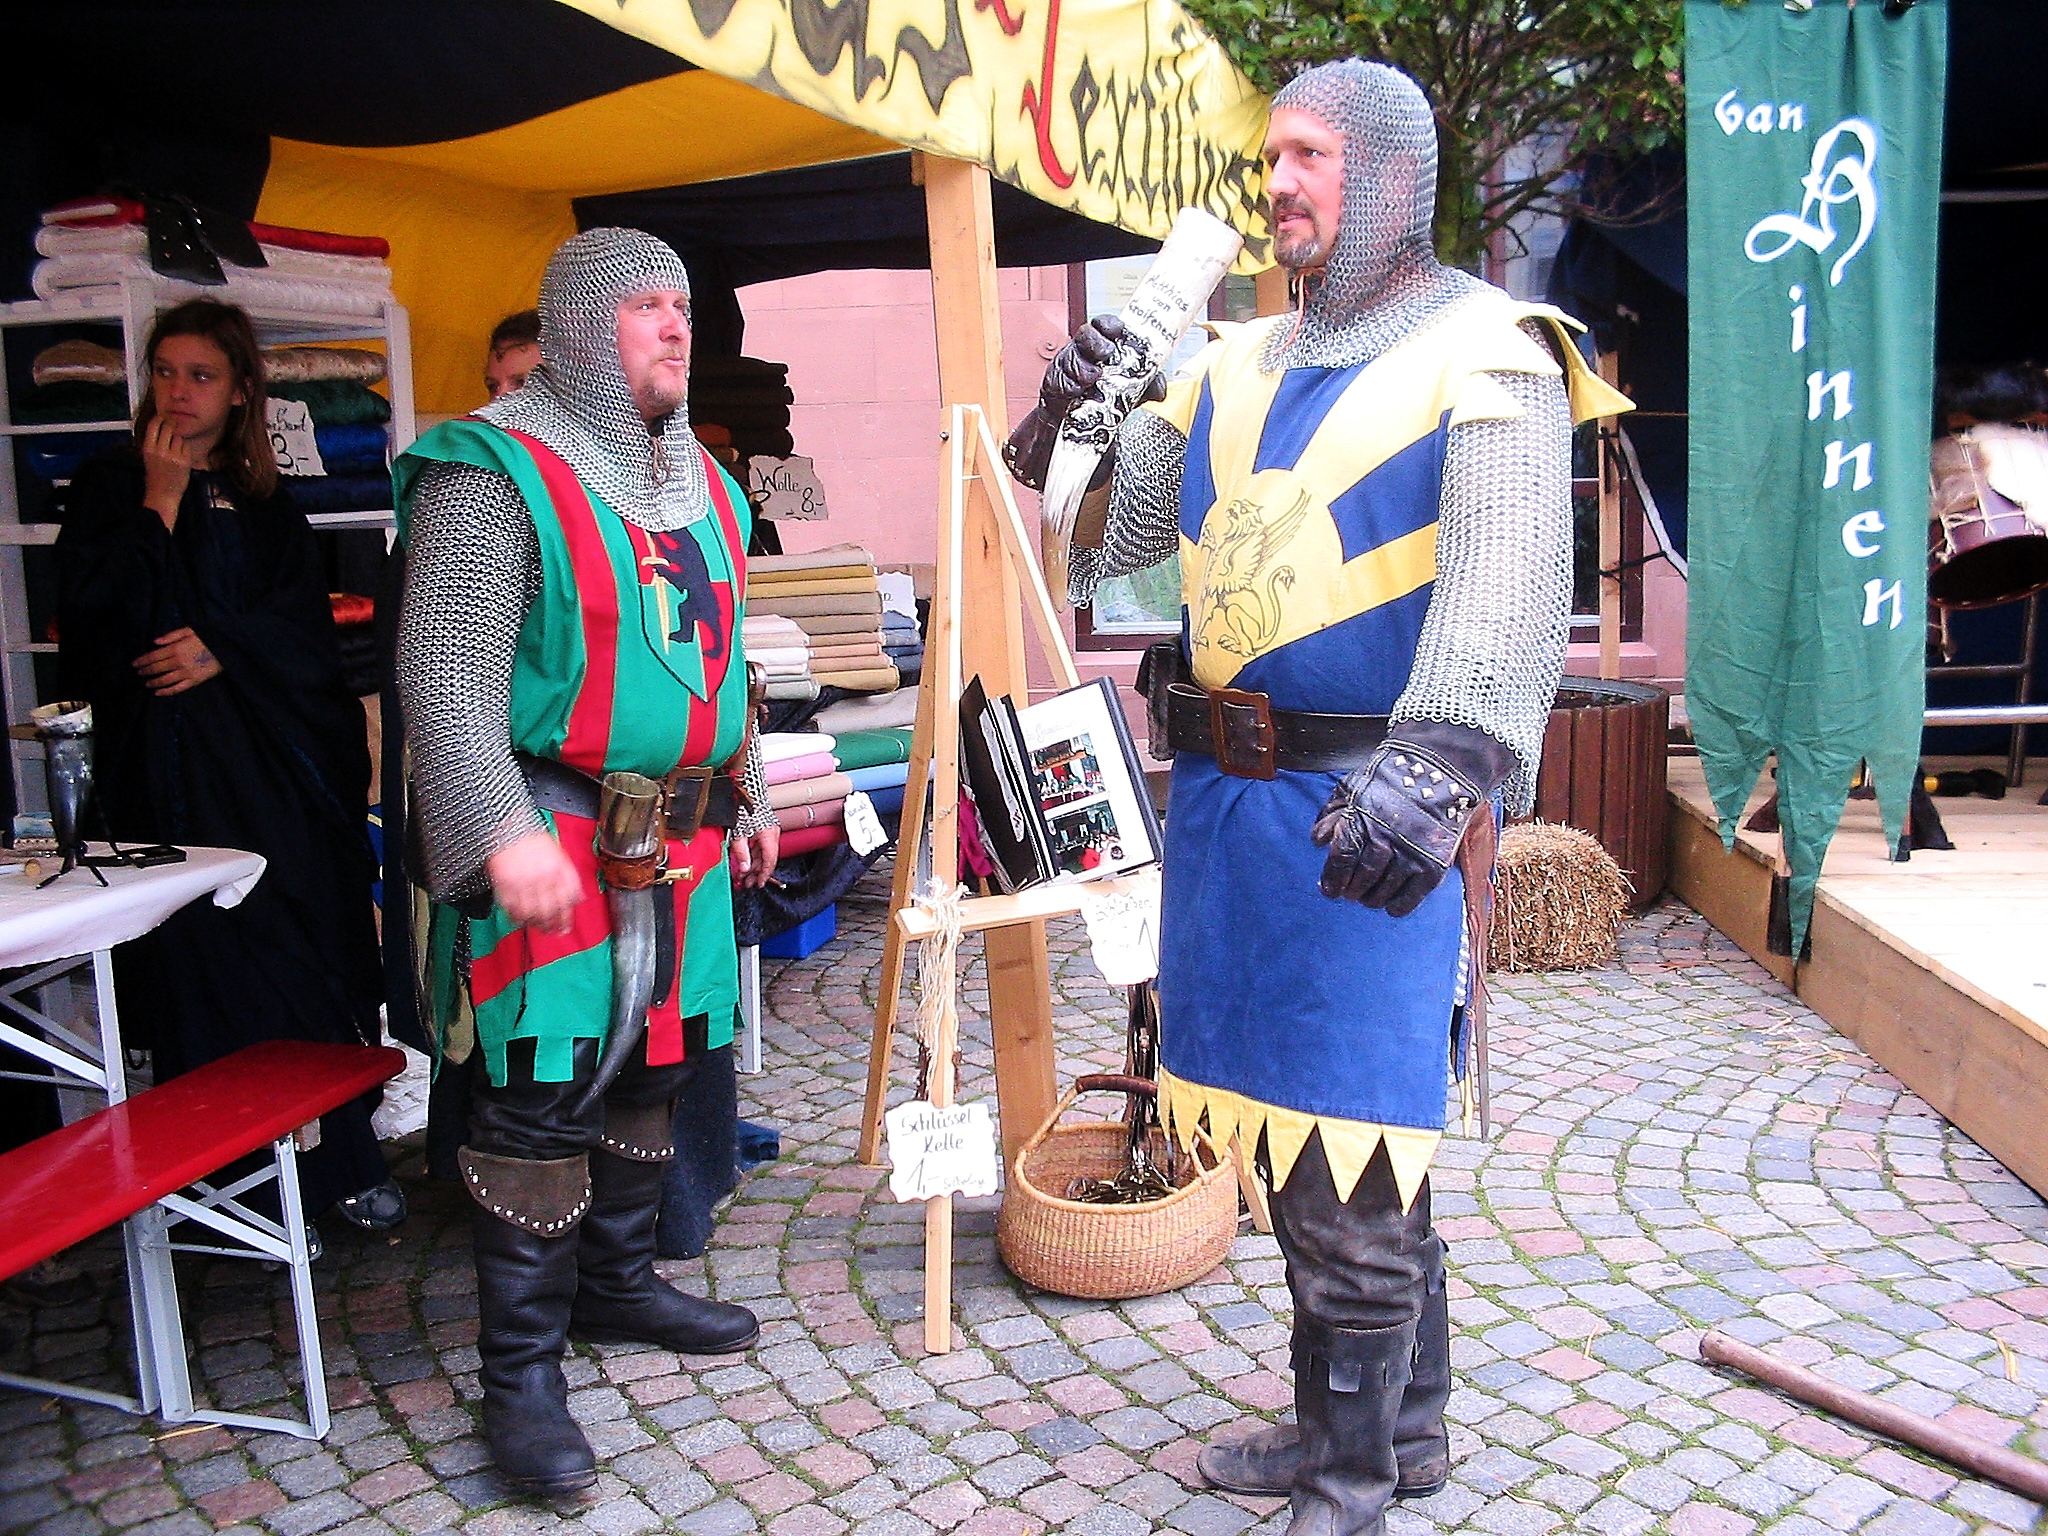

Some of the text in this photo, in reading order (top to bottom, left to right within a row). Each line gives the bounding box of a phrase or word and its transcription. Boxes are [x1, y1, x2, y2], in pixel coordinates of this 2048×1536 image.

[1153, 296, 1172, 312] von
[756, 466, 801, 493] Wolle
[901, 1108, 973, 1137] Schlüssel
[923, 1132, 964, 1154] Kelle
